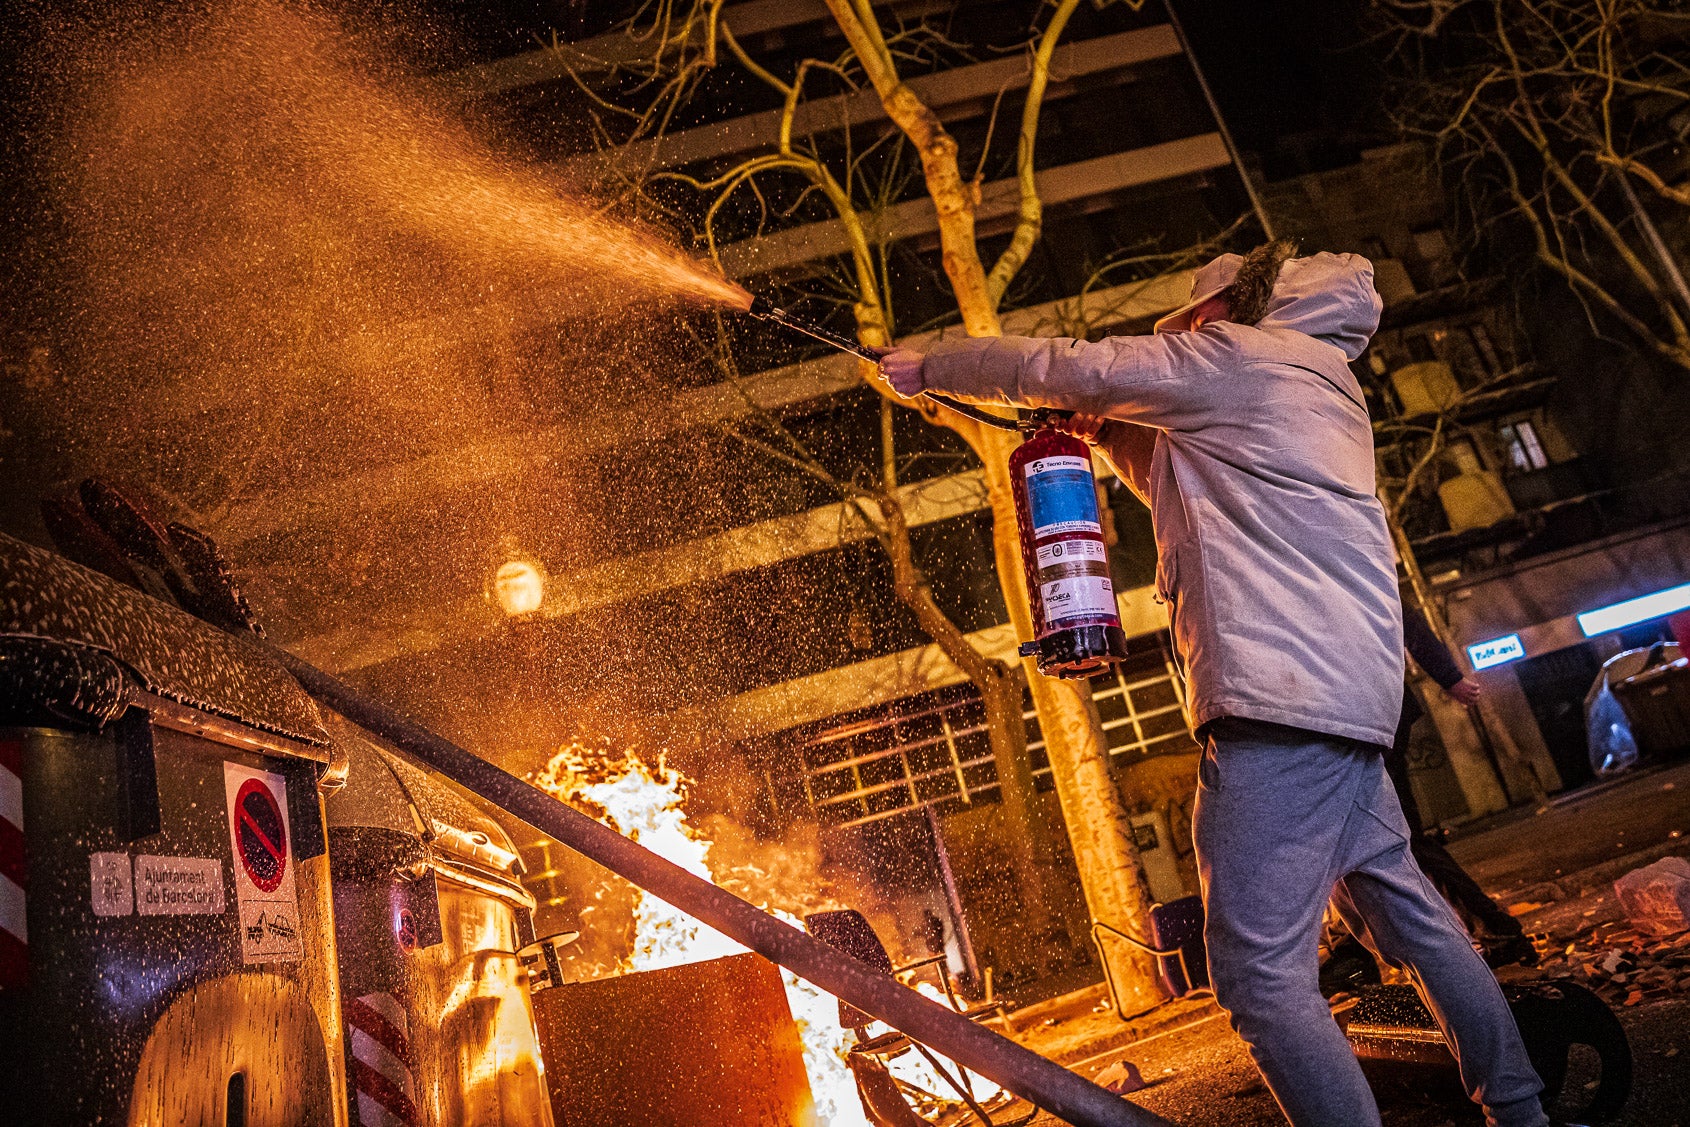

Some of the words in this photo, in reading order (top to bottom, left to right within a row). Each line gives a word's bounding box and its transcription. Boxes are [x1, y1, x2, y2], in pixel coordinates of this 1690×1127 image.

[145, 868, 205, 887] Ajuntament
[146, 888, 159, 904] de
[162, 888, 214, 904] Barcelona
